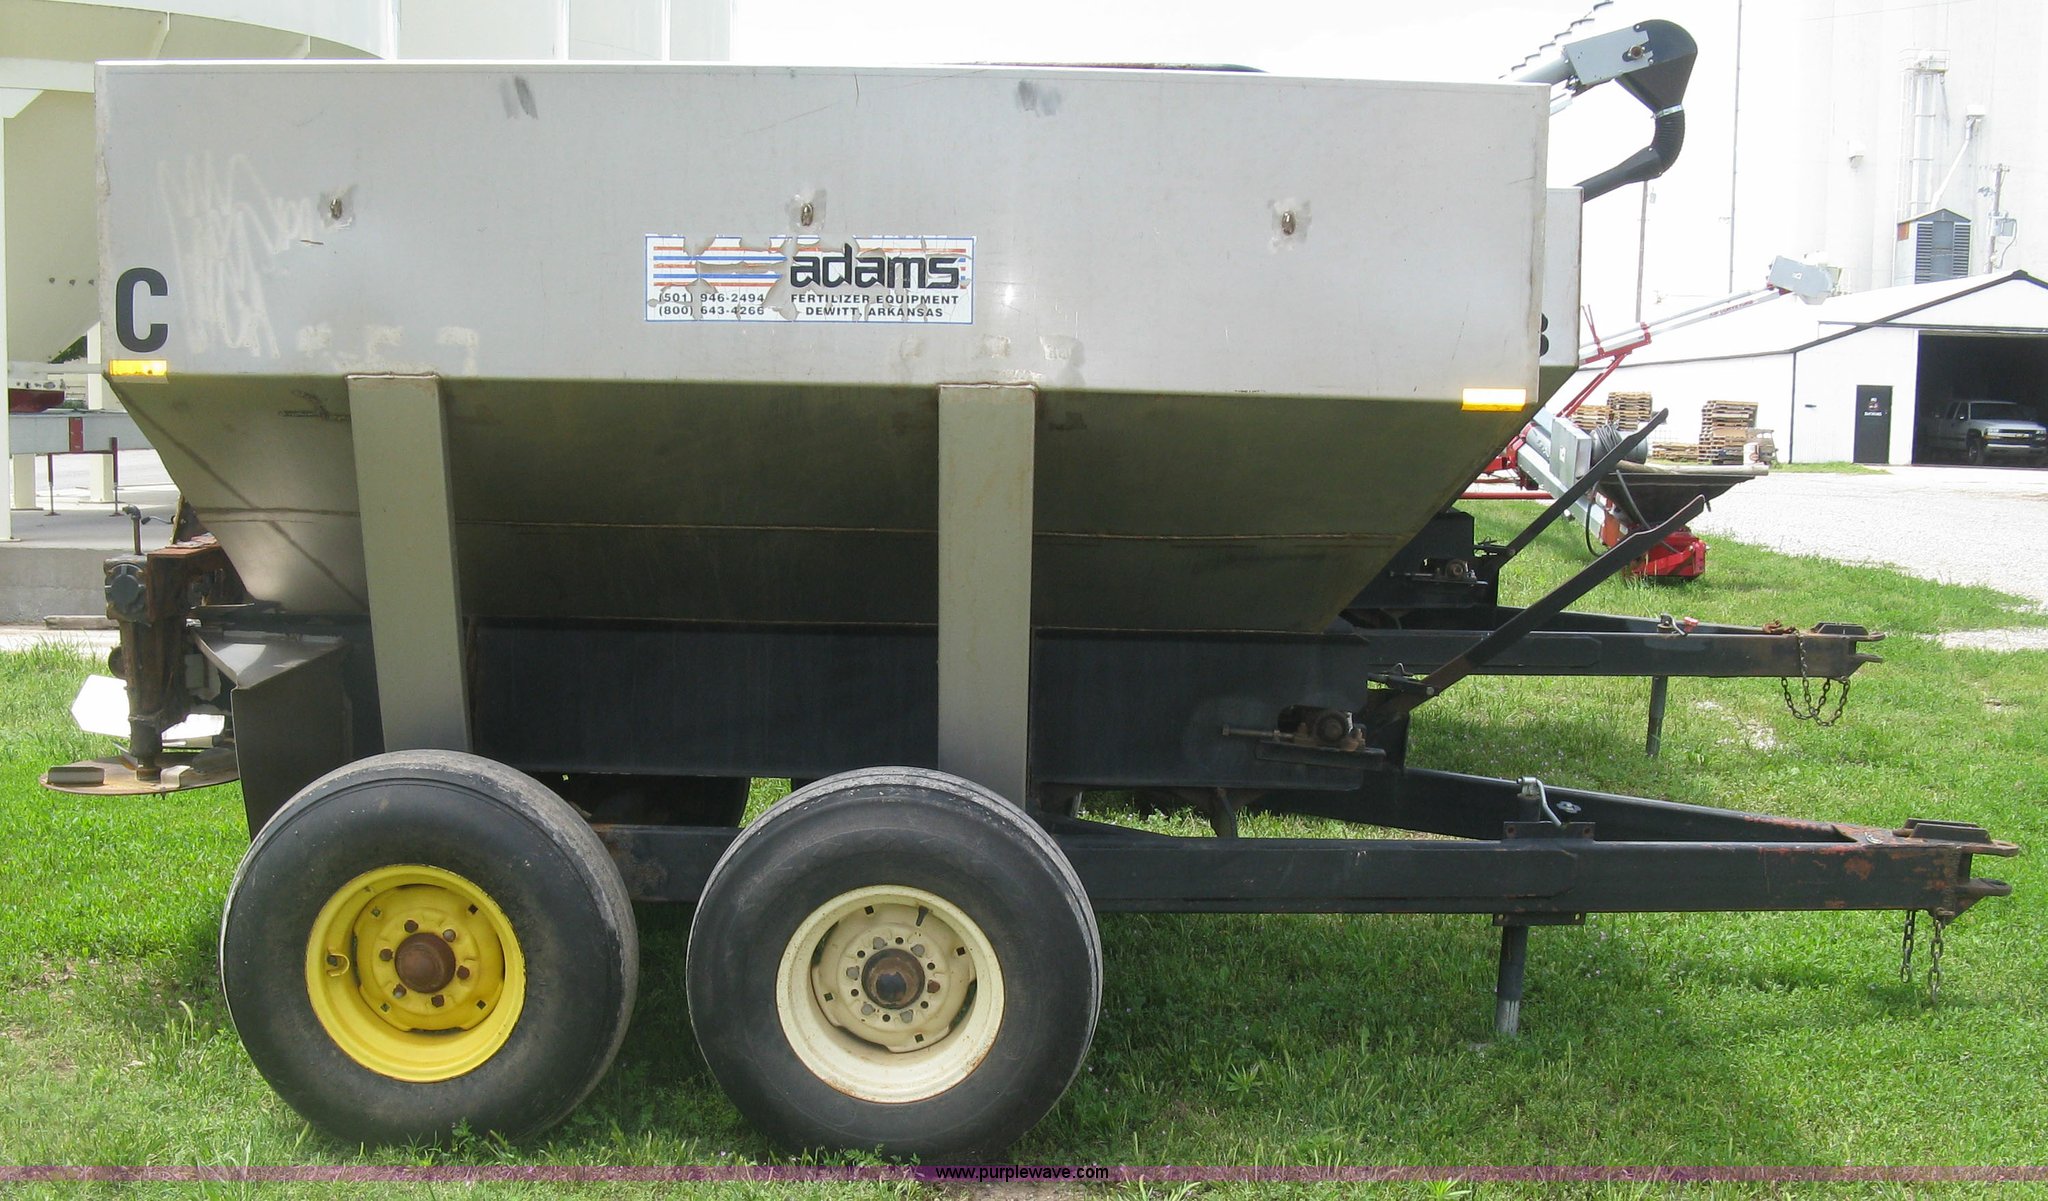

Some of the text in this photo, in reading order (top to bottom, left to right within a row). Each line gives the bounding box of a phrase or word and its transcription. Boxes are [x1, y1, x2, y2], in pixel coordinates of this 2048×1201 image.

[790, 242, 960, 289] adams
[659, 293, 765, 303] (501) 946-2494
[791, 294, 959, 305] FERTILIZER EQUIPMENT
[115, 267, 169, 353] C
[659, 306, 765, 316] (800) 643-4266
[806, 306, 943, 317] DEWITT, ARKANSAS
